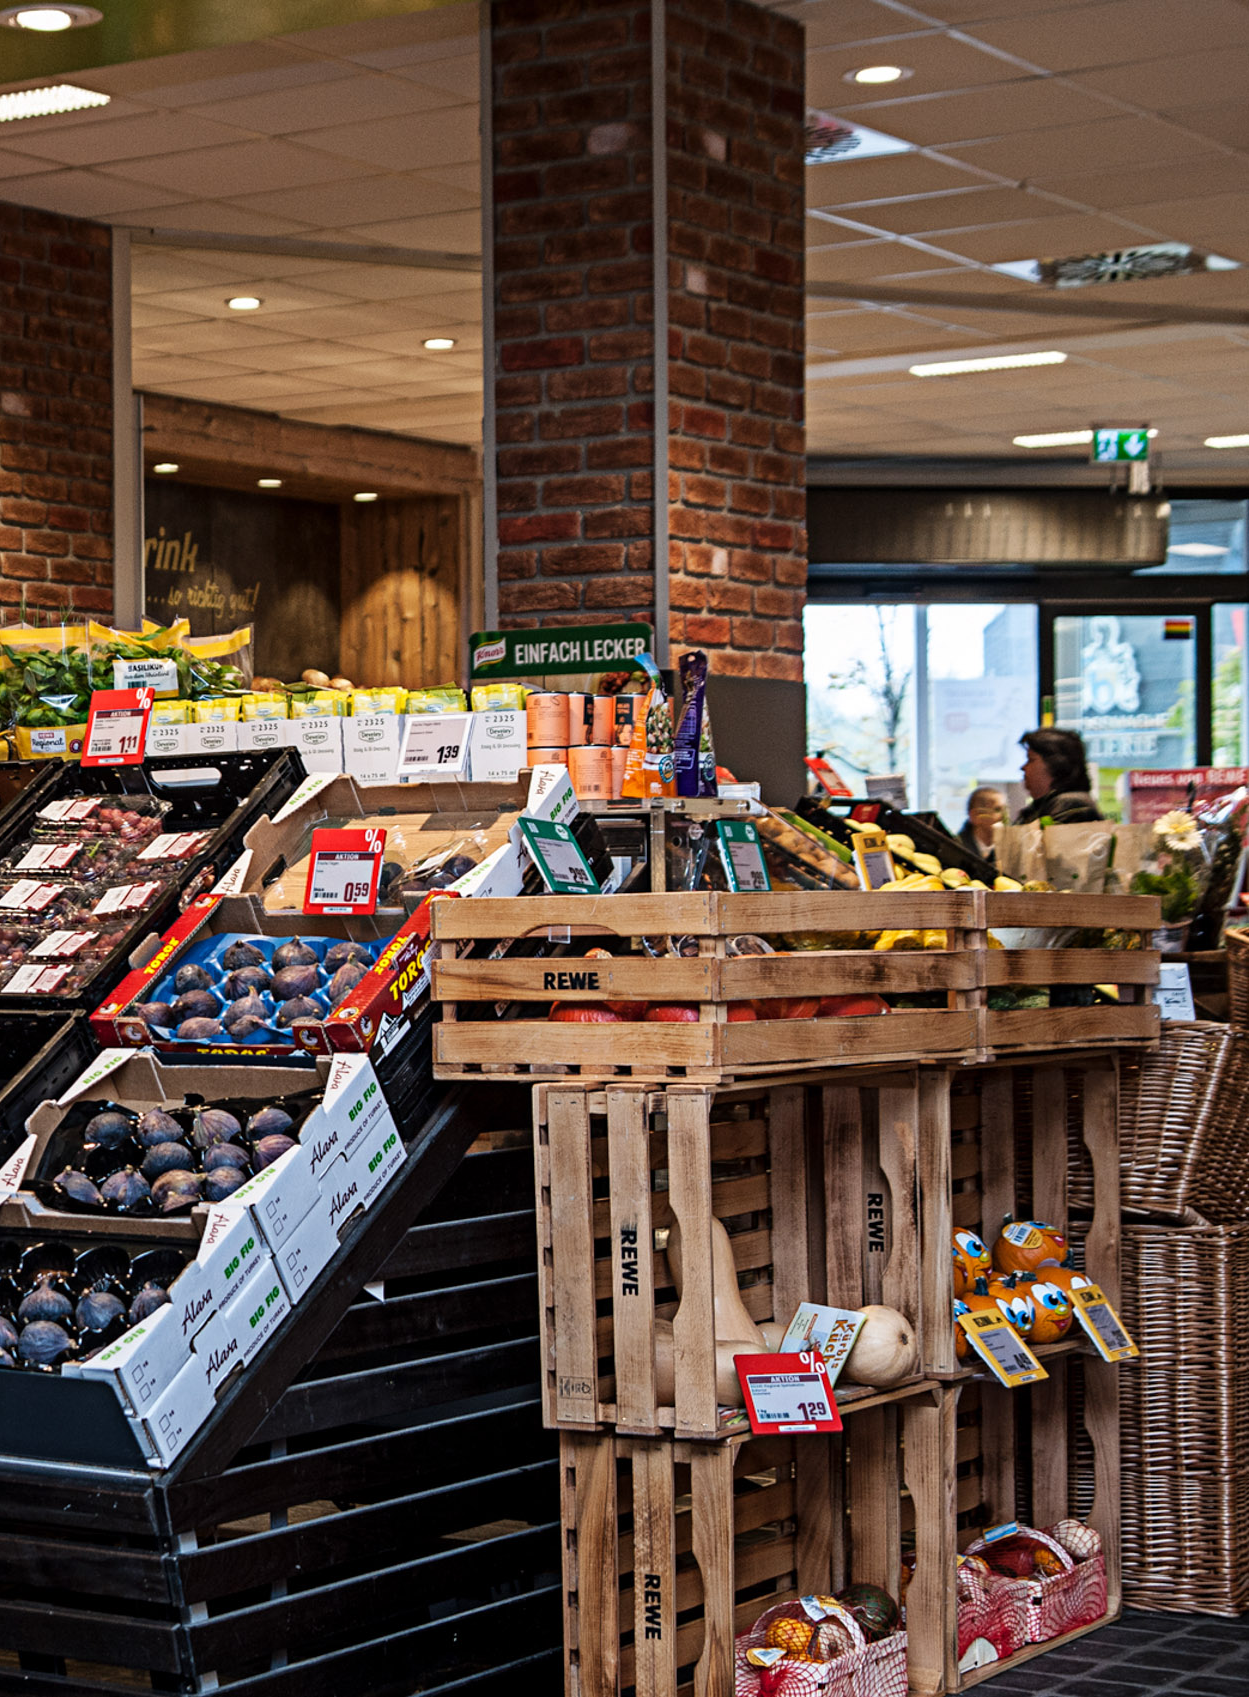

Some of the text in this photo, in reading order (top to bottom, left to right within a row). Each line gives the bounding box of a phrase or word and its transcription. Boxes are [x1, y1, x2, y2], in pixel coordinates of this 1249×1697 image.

[230, 581, 260, 619] gut!
[475, 637, 646, 665] Knorr EINFACH LECKER
[159, 728, 179, 737] 2325
[259, 723, 278, 731] 2325
[308, 720, 328, 728] 2325
[364, 718, 384, 726] 2325
[32, 736, 64, 748] Regional
[119, 735, 138, 754] 1.11
[436, 745, 460, 764] 1.39
[562, 787, 573, 805] FIG
[365, 829, 381, 853] %
[344, 882, 369, 902] 0.59
[543, 972, 600, 990] REWE
[83, 1056, 123, 1085] BIG FIG
[331, 1060, 352, 1090] Alara
[348, 1081, 378, 1122] BIG FIG
[344, 1100, 383, 1150] PRODUCE OF TURKEY
[309, 1131, 339, 1175] Alara
[367, 1133, 397, 1173] BIG FIG
[1, 1157, 25, 1188] Alara
[363, 1151, 403, 1201] PRODUCE OF TURKEY
[328, 1181, 358, 1226] Alara
[206, 1212, 230, 1244] Alara
[866, 1191, 885, 1253] REWE
[223, 1237, 256, 1280] BIG FIG
[620, 1228, 639, 1297] REWE
[218, 1255, 262, 1310] PRODUCE OF TURKEY
[181, 1288, 213, 1336] Alara
[249, 1285, 281, 1329] BIG FIG
[100, 1327, 146, 1361] BIG FIG
[243, 1303, 287, 1360] PRODUCE OF TURKEY
[831, 1322, 856, 1369] Kürbis
[205, 1337, 238, 1385] Alara
[800, 1352, 825, 1374] %
[797, 1401, 826, 1420] 1.29
[644, 1574, 661, 1640] REWE
